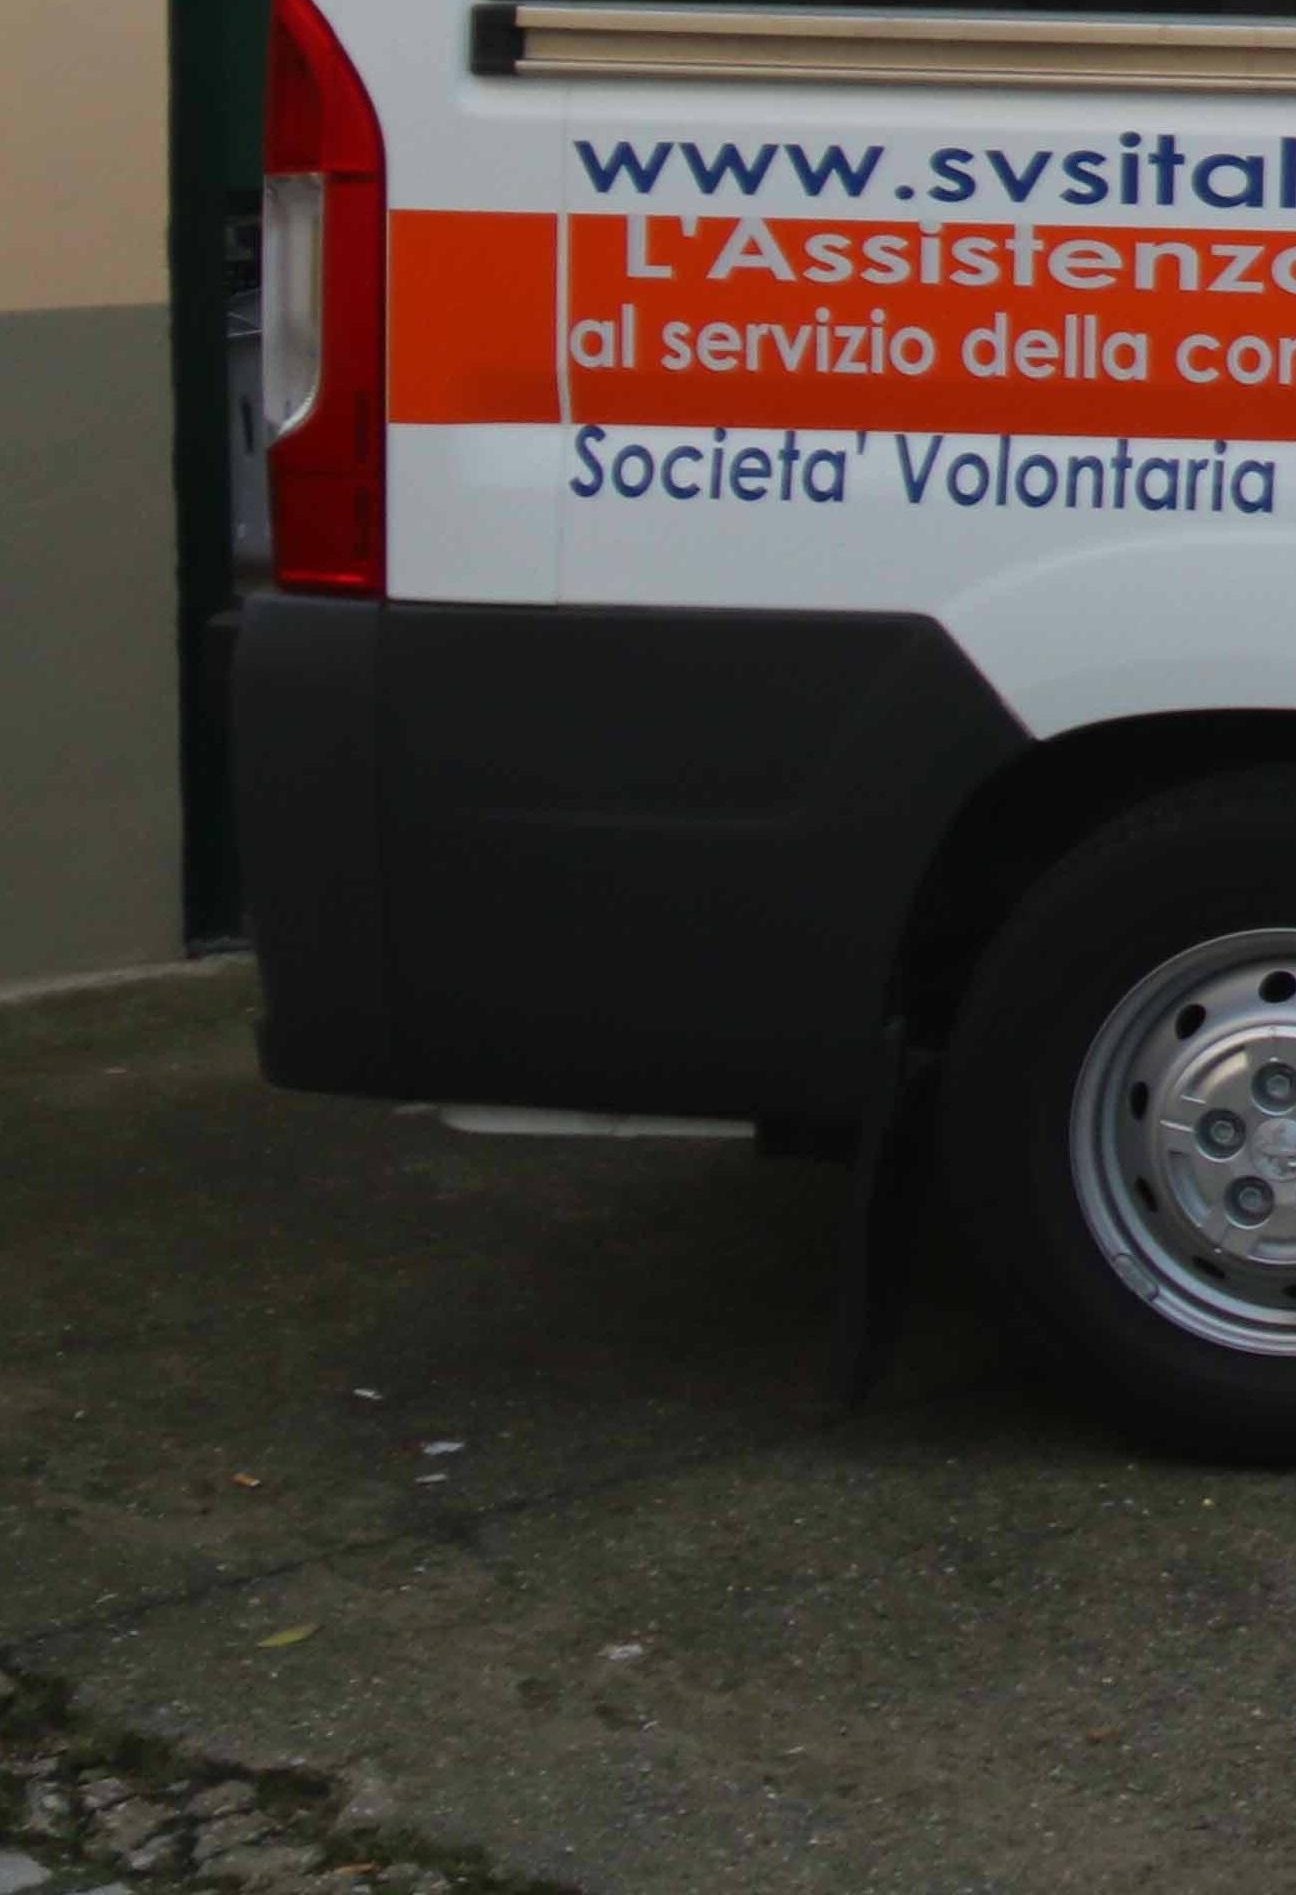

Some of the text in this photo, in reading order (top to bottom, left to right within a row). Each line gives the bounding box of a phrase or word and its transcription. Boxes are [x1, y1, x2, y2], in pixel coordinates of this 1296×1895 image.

[569, 304, 636, 369] al
[661, 307, 936, 376] servizio
[962, 311, 1149, 383] della
[569, 425, 868, 503] Societa'
[895, 431, 1275, 515] Volontaria
